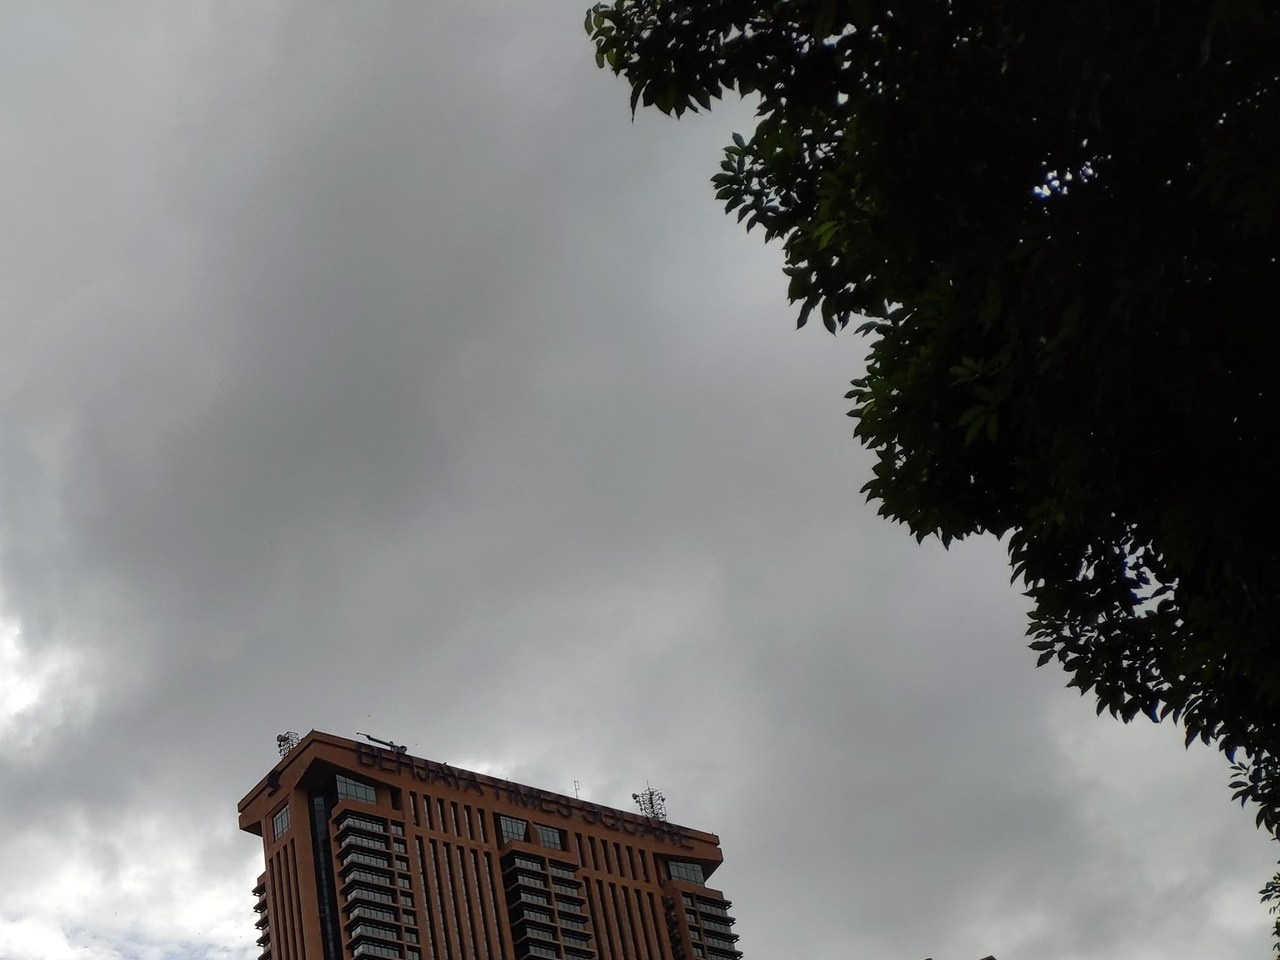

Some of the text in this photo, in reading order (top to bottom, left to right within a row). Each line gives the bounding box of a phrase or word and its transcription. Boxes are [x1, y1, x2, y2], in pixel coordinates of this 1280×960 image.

[357, 745, 694, 849] BERJAYA TIMES SQUARE
